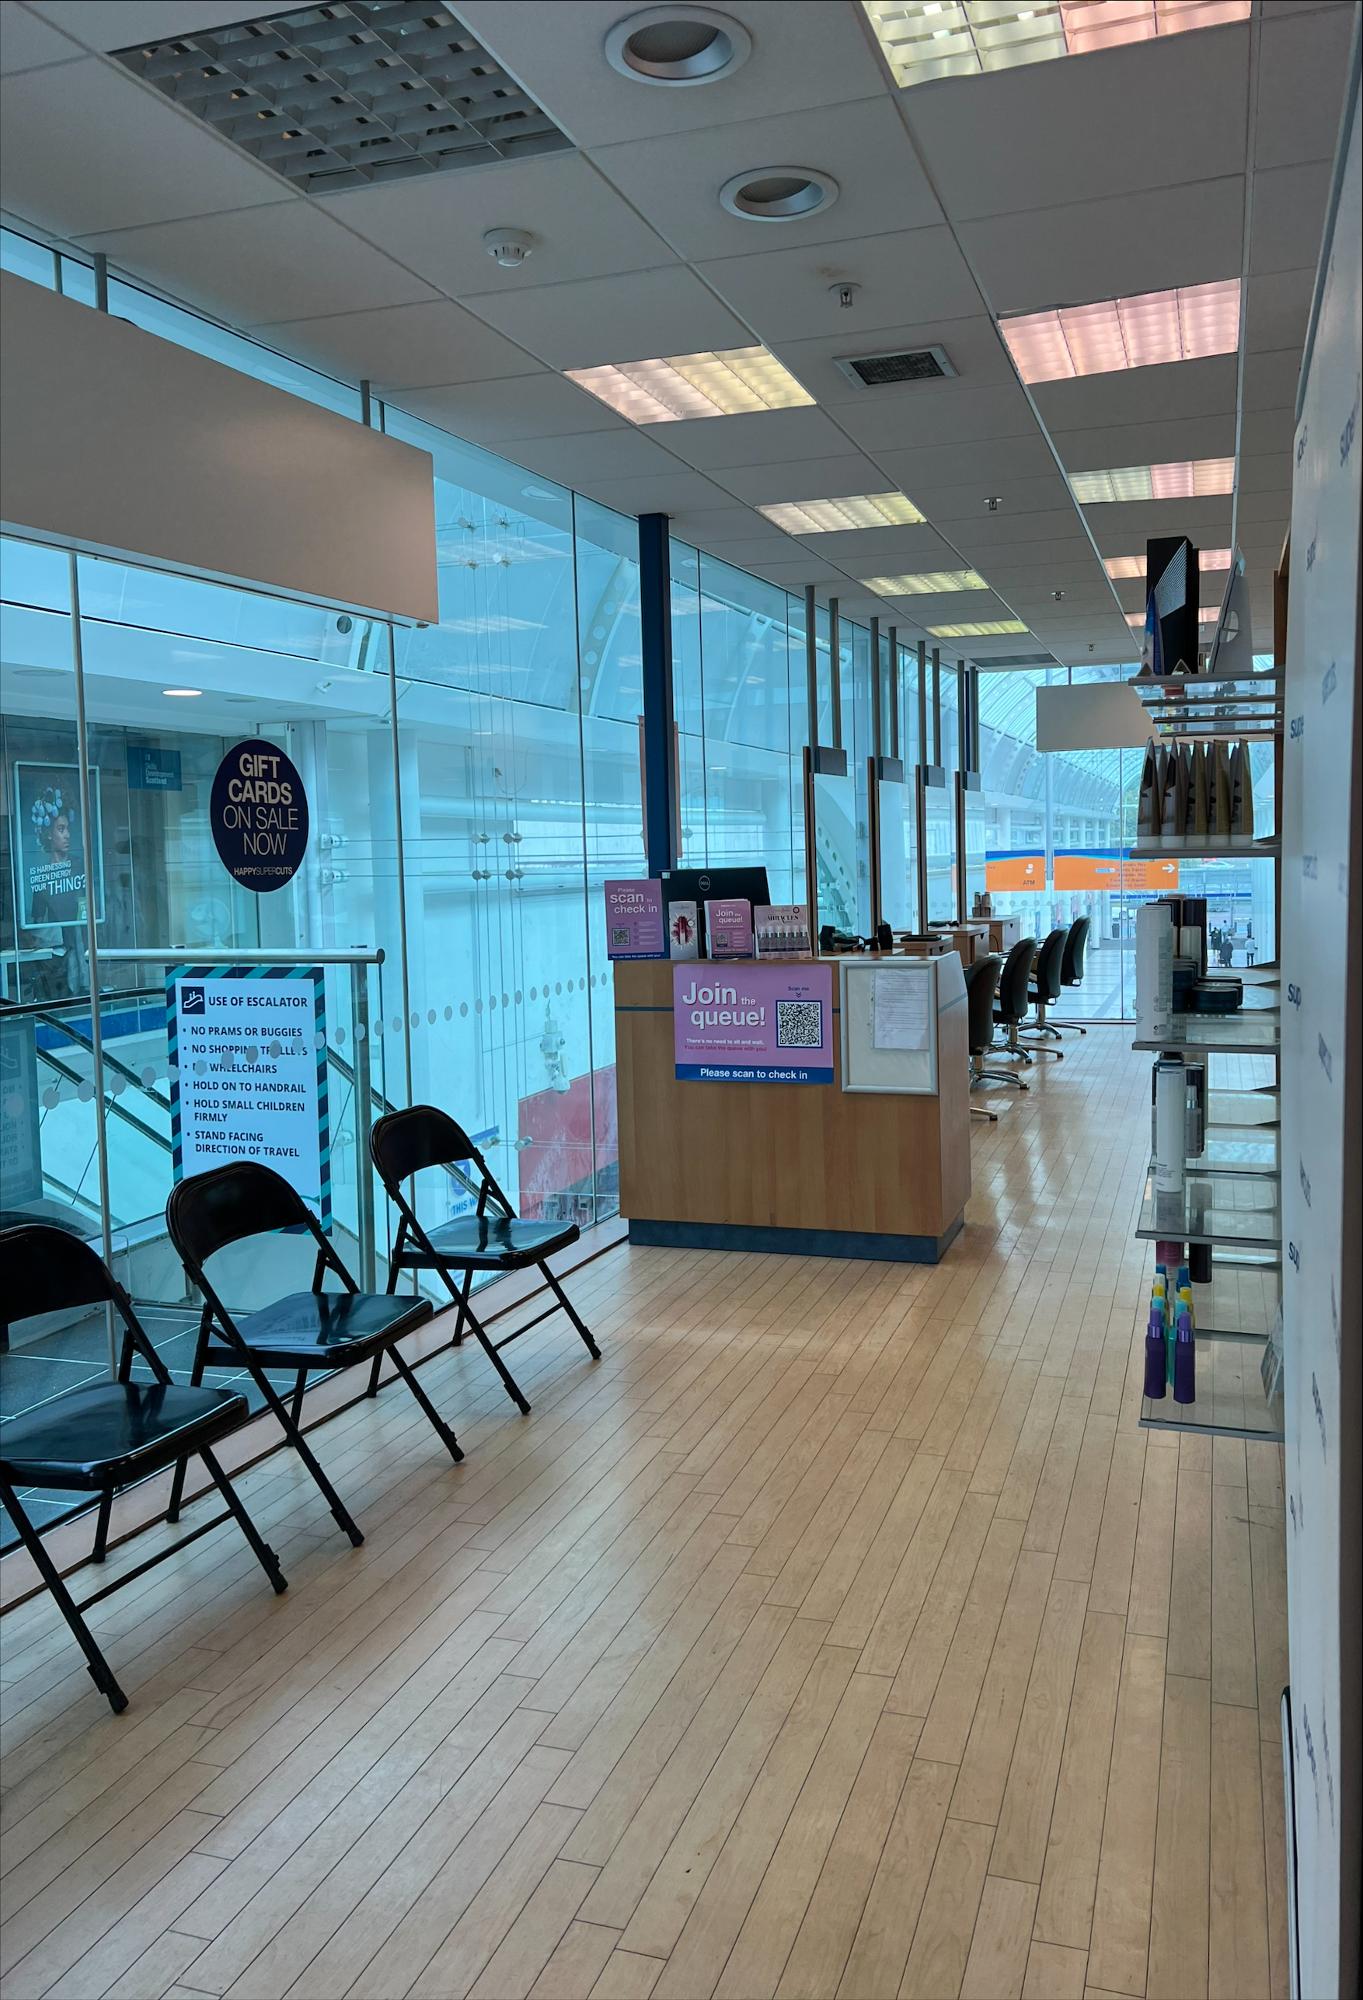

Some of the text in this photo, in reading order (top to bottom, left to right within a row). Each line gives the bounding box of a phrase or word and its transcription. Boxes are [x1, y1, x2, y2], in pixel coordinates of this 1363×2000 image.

[239, 753, 280, 779] GIFT
[228, 779, 293, 805] CARDS
[223, 805, 299, 830] ON SALE
[243, 832, 287, 856] NOW
[30, 860, 72, 875] IS HARNESSING
[31, 869, 72, 884] GREEN ENERGY
[31, 873, 86, 895] YOUR THING?
[610, 893, 644, 904] scan
[614, 904, 658, 914] check in
[715, 909, 734, 917] Join
[718, 916, 743, 924] queue!
[682, 982, 756, 1006] Join the
[208, 996, 308, 1008] USE OF ESCALATOR
[691, 1007, 765, 1030] queue!
[191, 1026, 303, 1037] NO PRAMS OR BUGGIES
[192, 1045, 206, 1054] NO
[209, 1045, 255, 1055] SHOPPIN
[700, 1068, 808, 1080] Please scan to check in
[193, 1081, 306, 1093] HOLD ON TO HANDRAIL
[193, 1099, 305, 1112] HOLD SMALL CHILDREN
[194, 1112, 228, 1122] FIRMLY
[195, 1130, 264, 1142] STAND FACING
[195, 1144, 300, 1157] DIRECTION OF TRAVEL
[452, 1199, 468, 1215] THIS
